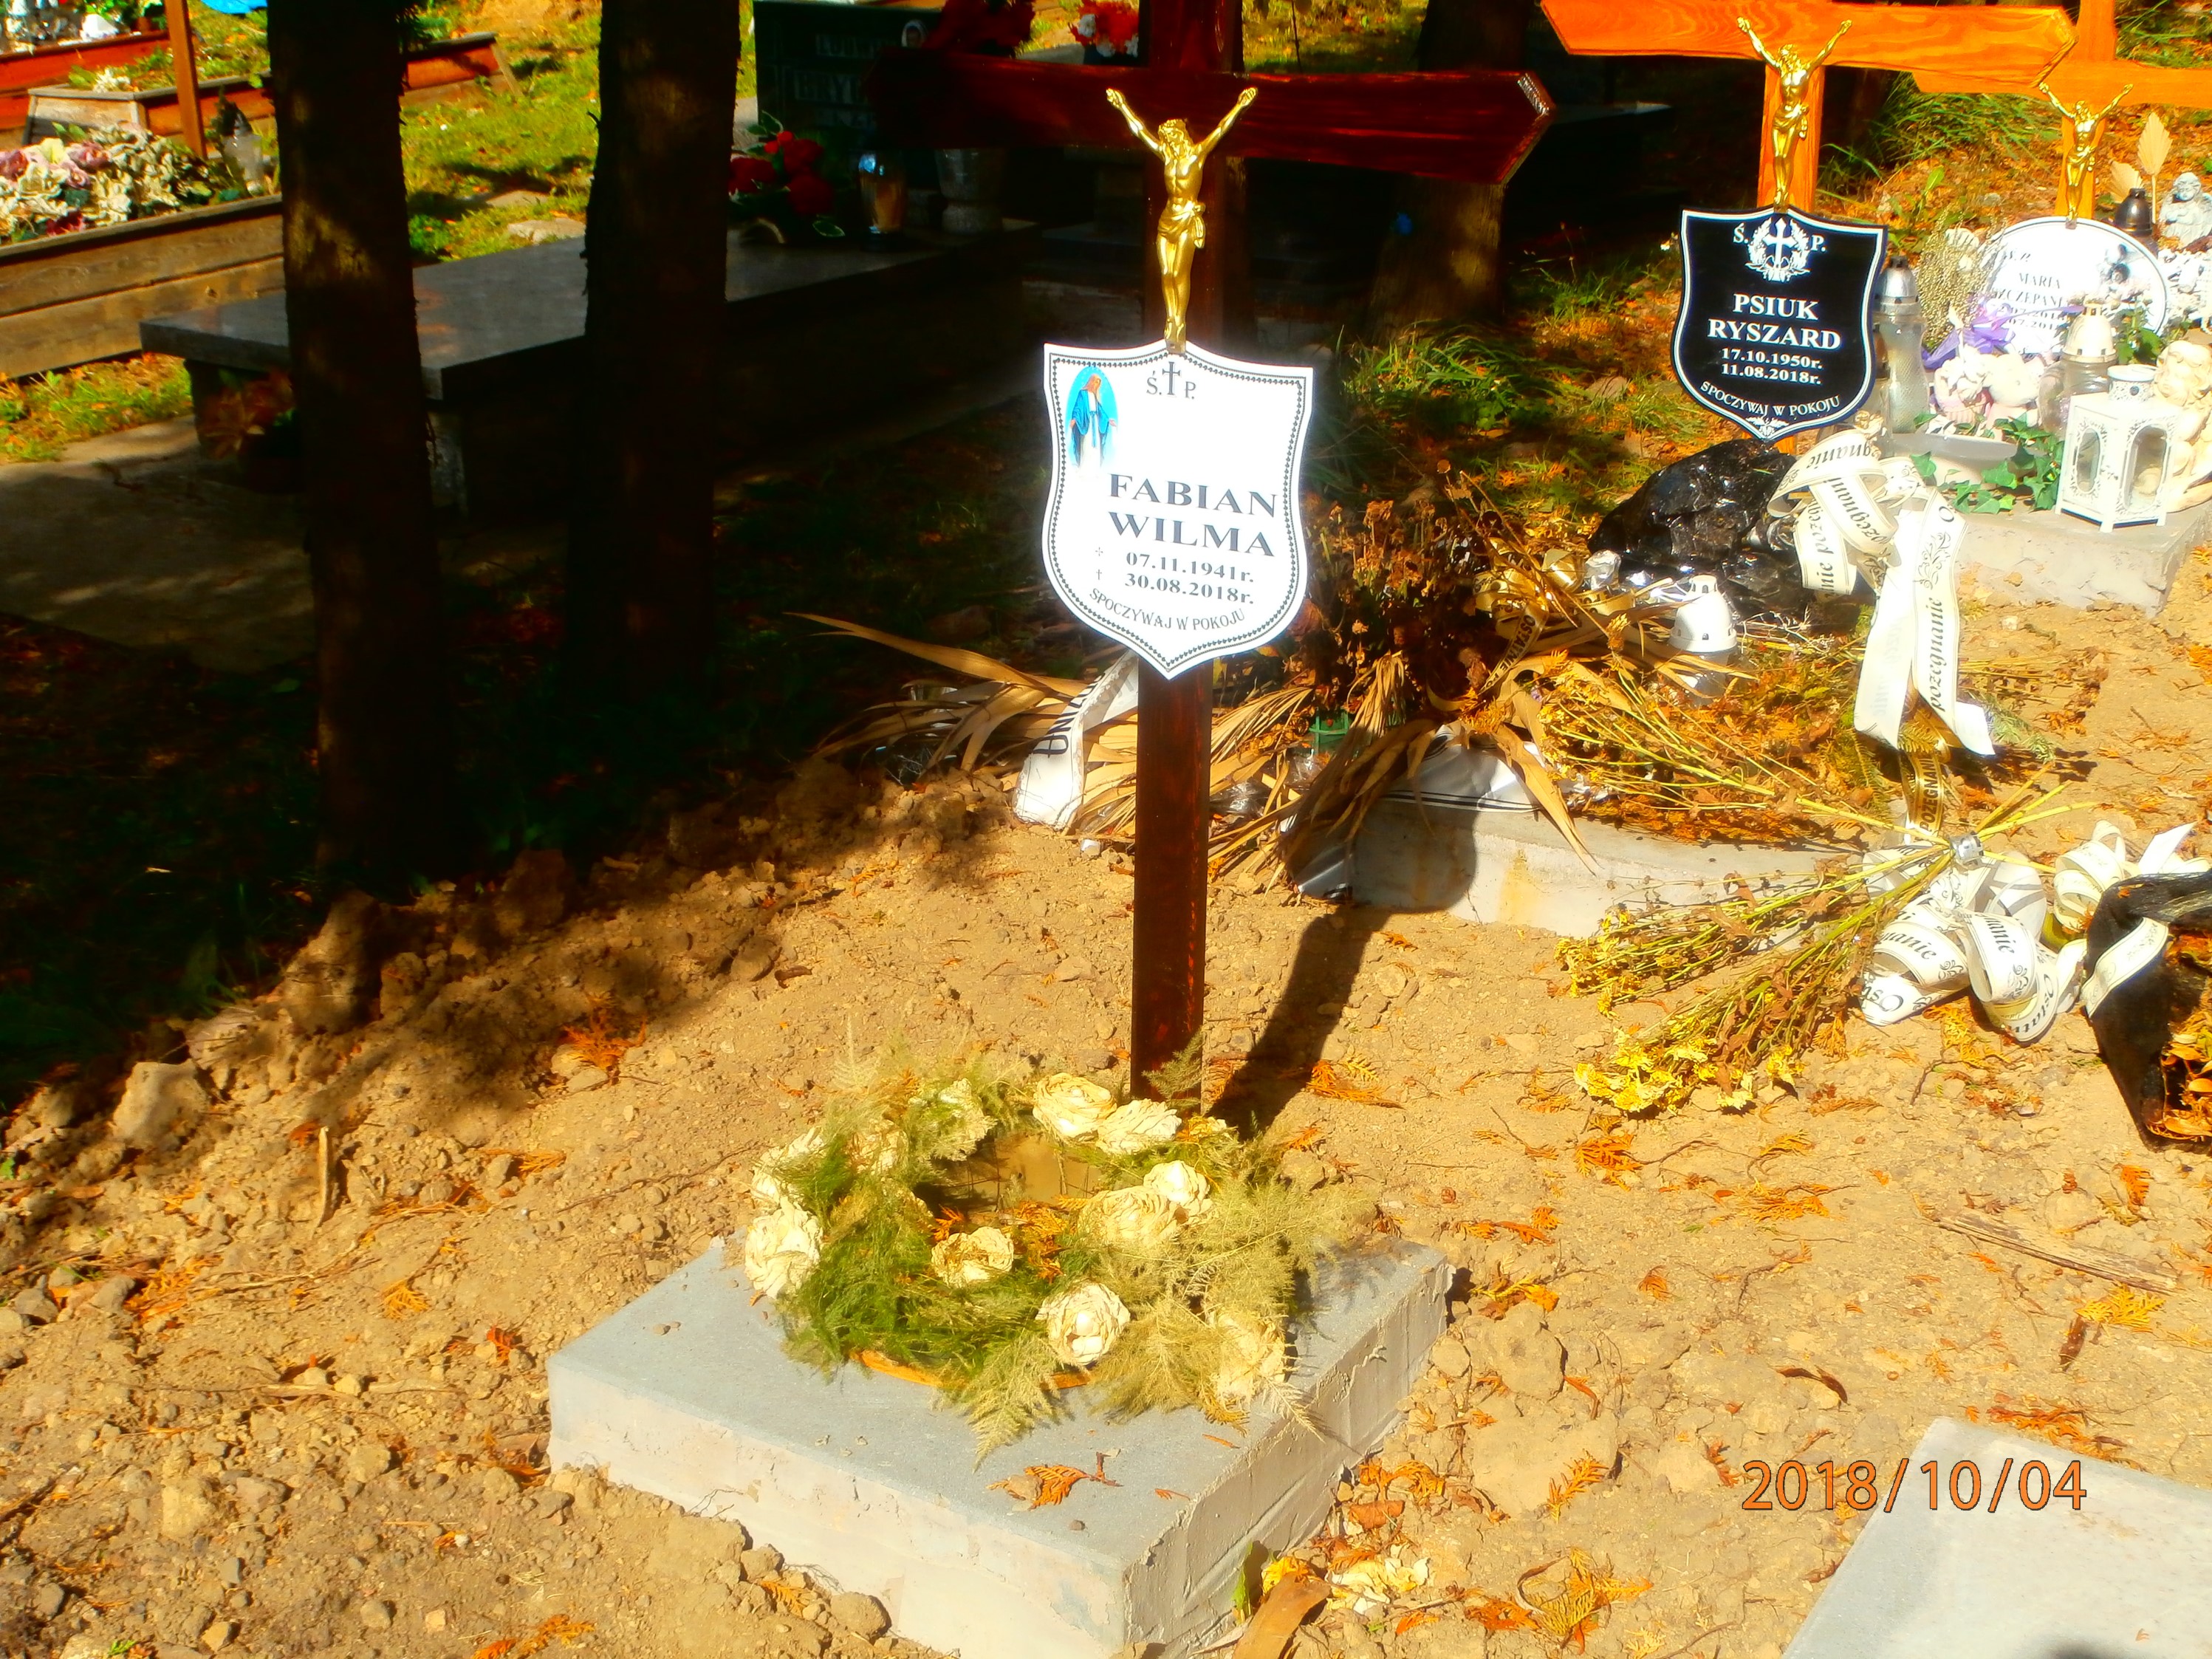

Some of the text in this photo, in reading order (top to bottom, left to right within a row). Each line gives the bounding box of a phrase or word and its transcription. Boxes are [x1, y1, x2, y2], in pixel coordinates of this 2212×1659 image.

[1810, 235, 1826, 253] P.
[2018, 272, 2061, 290] MARIA
[1733, 293, 1820, 321] PSIUK
[1707, 318, 1841, 350] RYSZARD
[1721, 347, 1824, 369] 17.10.1950r.
[1721, 363, 1822, 385] 11.08.2018r.
[1184, 381, 1196, 400] P.
[1699, 380, 1841, 417] SPOCZYWAJ W POKOJU
[1108, 473, 1278, 518] FABIAN
[1108, 511, 1276, 557] WILMA
[1126, 552, 1254, 583] 07.11.1941r.
[1124, 573, 1254, 605] 30.08.2018r.
[1089, 587, 1246, 631] SPOCZYWAJ W POKOJU
